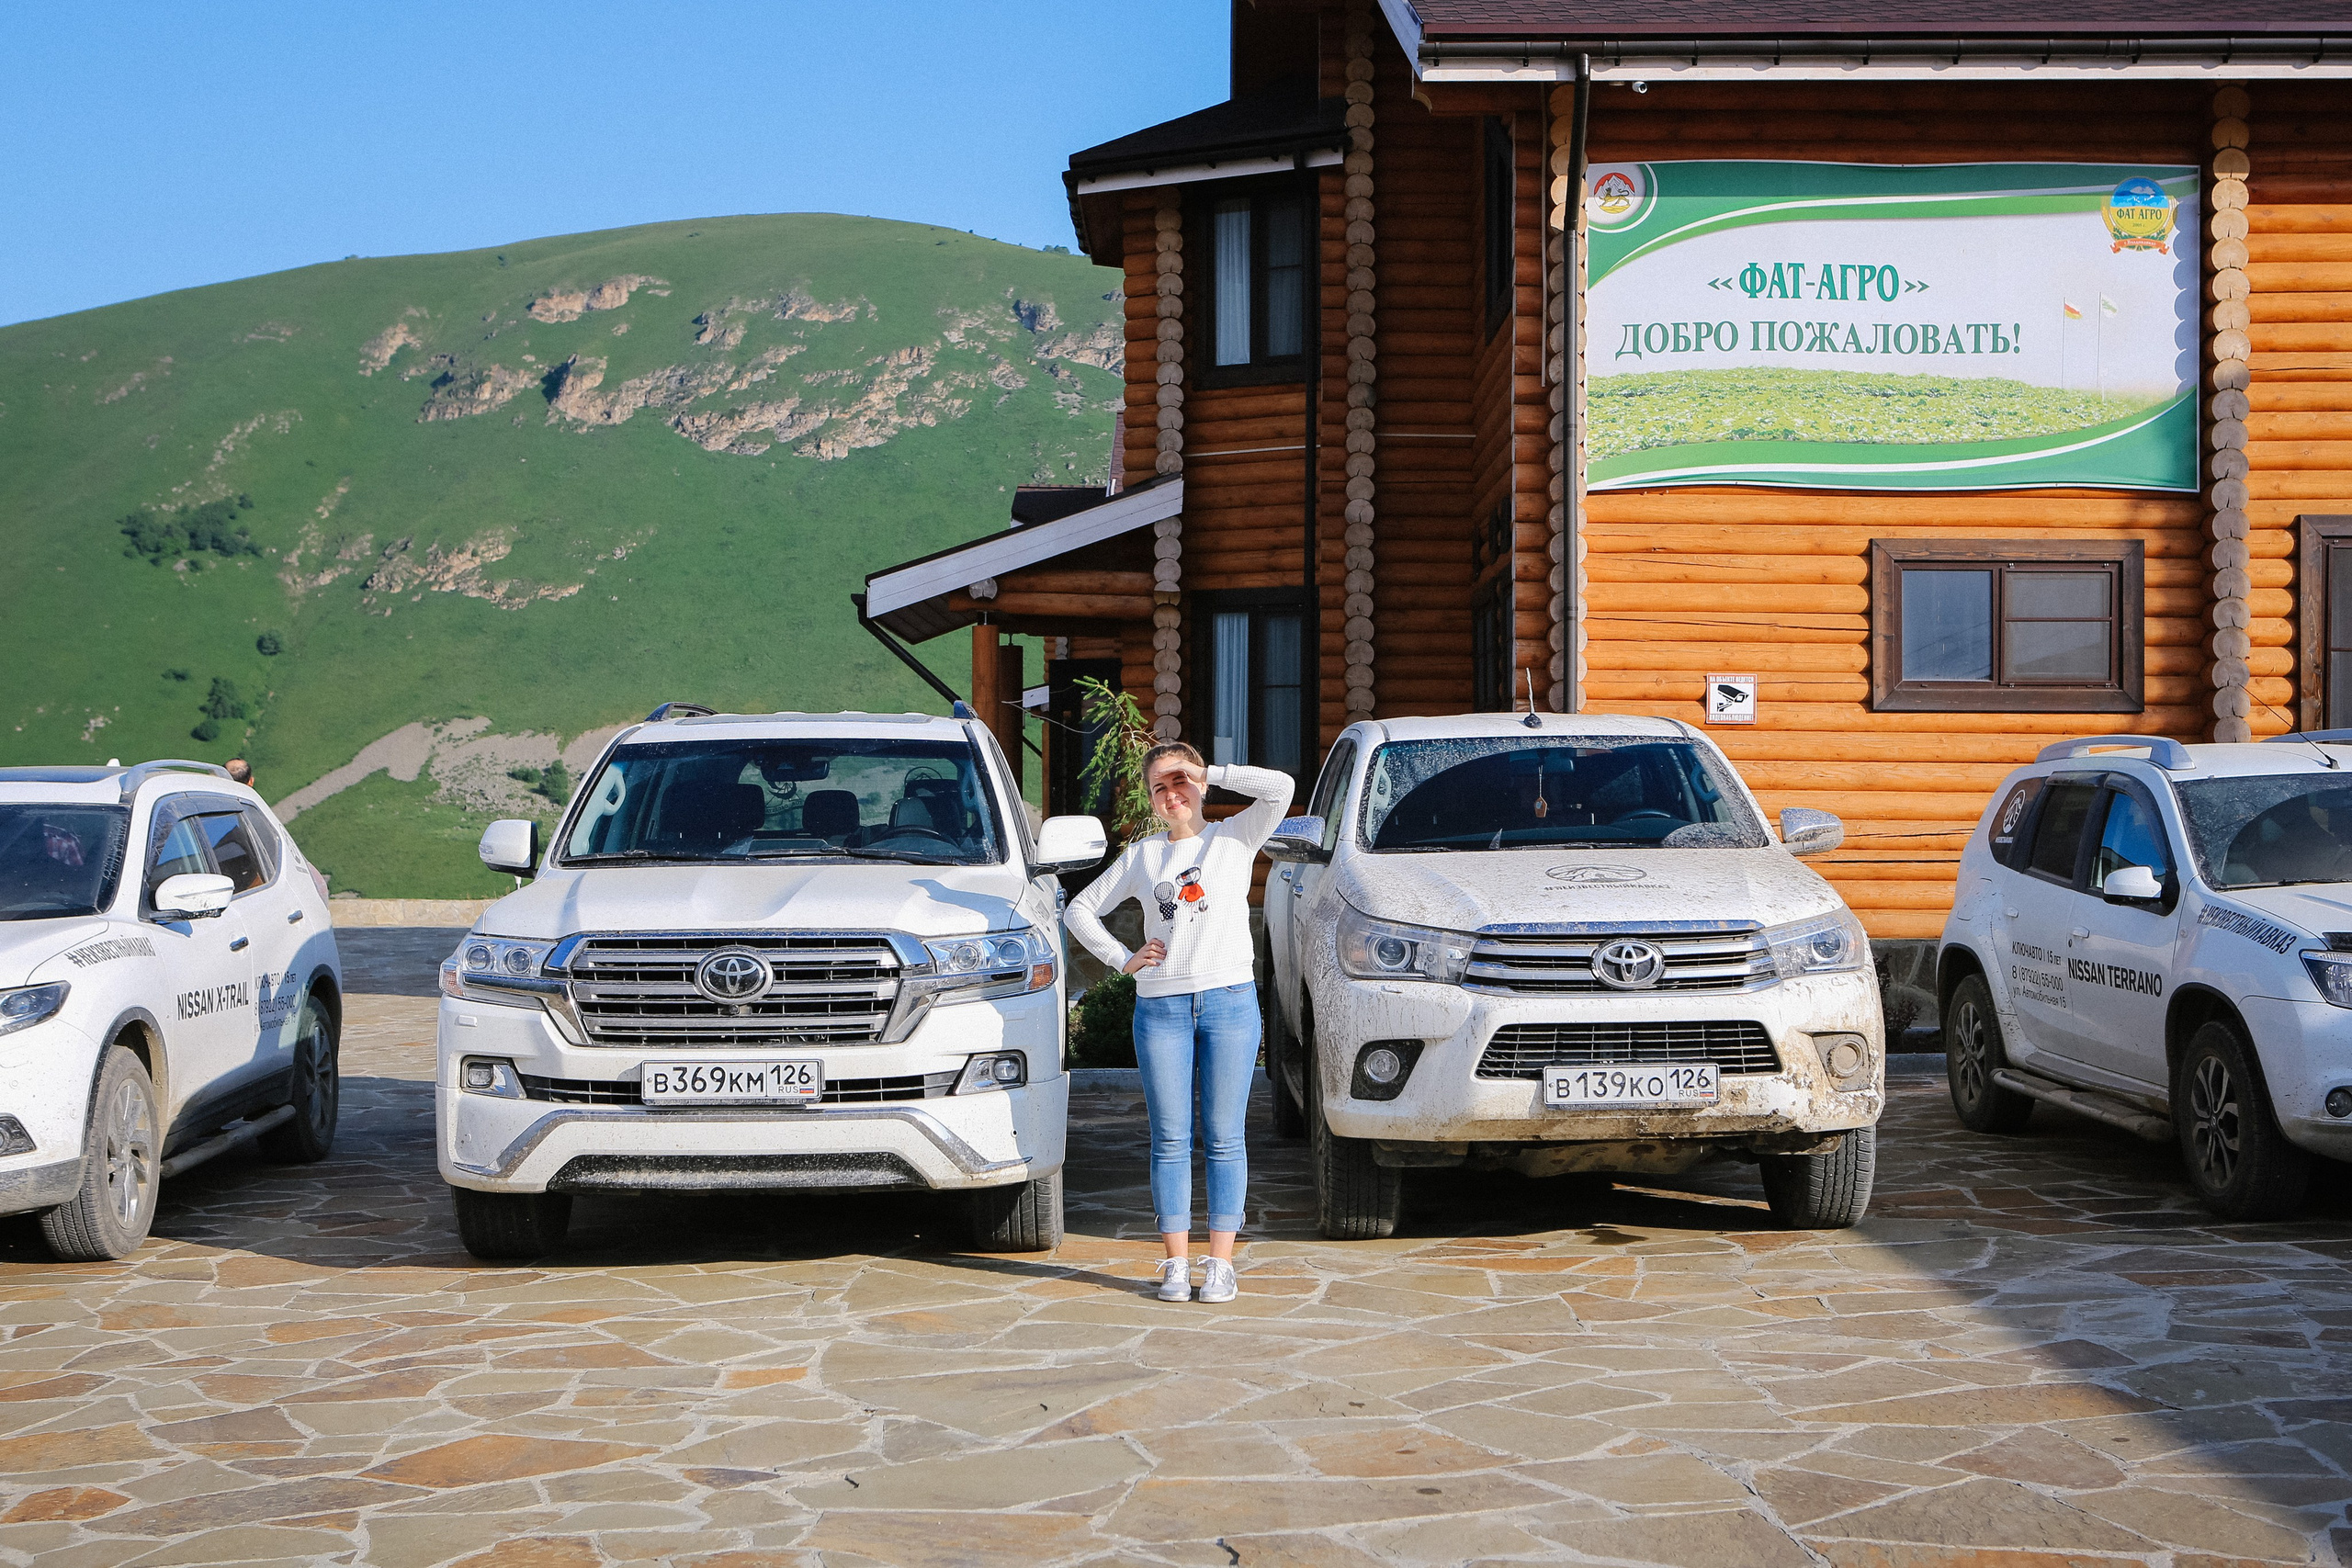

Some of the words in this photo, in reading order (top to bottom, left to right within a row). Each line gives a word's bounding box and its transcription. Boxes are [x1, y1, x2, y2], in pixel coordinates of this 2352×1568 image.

[2116, 209, 2135, 219] ФАТ
[2138, 209, 2162, 220] АГРО
[1615, 322, 1739, 361] ДОБРО
[1749, 321, 2021, 355] ПОЖАЛОВАТЬ!
[2197, 904, 2297, 954] #НЕИЗВЕСТНЫЙКАВКАЗ
[2012, 941, 2041, 961] КЛЮЧАВТО
[2046, 950, 2052, 964] 15
[2053, 955, 2062, 965] ЛЕТ
[2011, 965, 2018, 979] 8
[2018, 966, 2041, 987] (87922)
[2041, 973, 2064, 992] 55-000
[2067, 957, 2106, 986] NISSAN
[2107, 964, 2163, 998] TERRANO
[177, 988, 214, 1021] NISSAN
[216, 981, 249, 1012] X-TRAIL
[2022, 986, 2059, 1006] Автомобильная
[2059, 996, 2067, 1009] 15
[653, 1066, 764, 1093] В369КМ
[770, 1065, 811, 1085] 126
[778, 1086, 799, 1094] RUS
[1555, 1071, 1665, 1099] В139КО
[1668, 1068, 1711, 1089] 126
[1678, 1089, 1700, 1098] RUS
